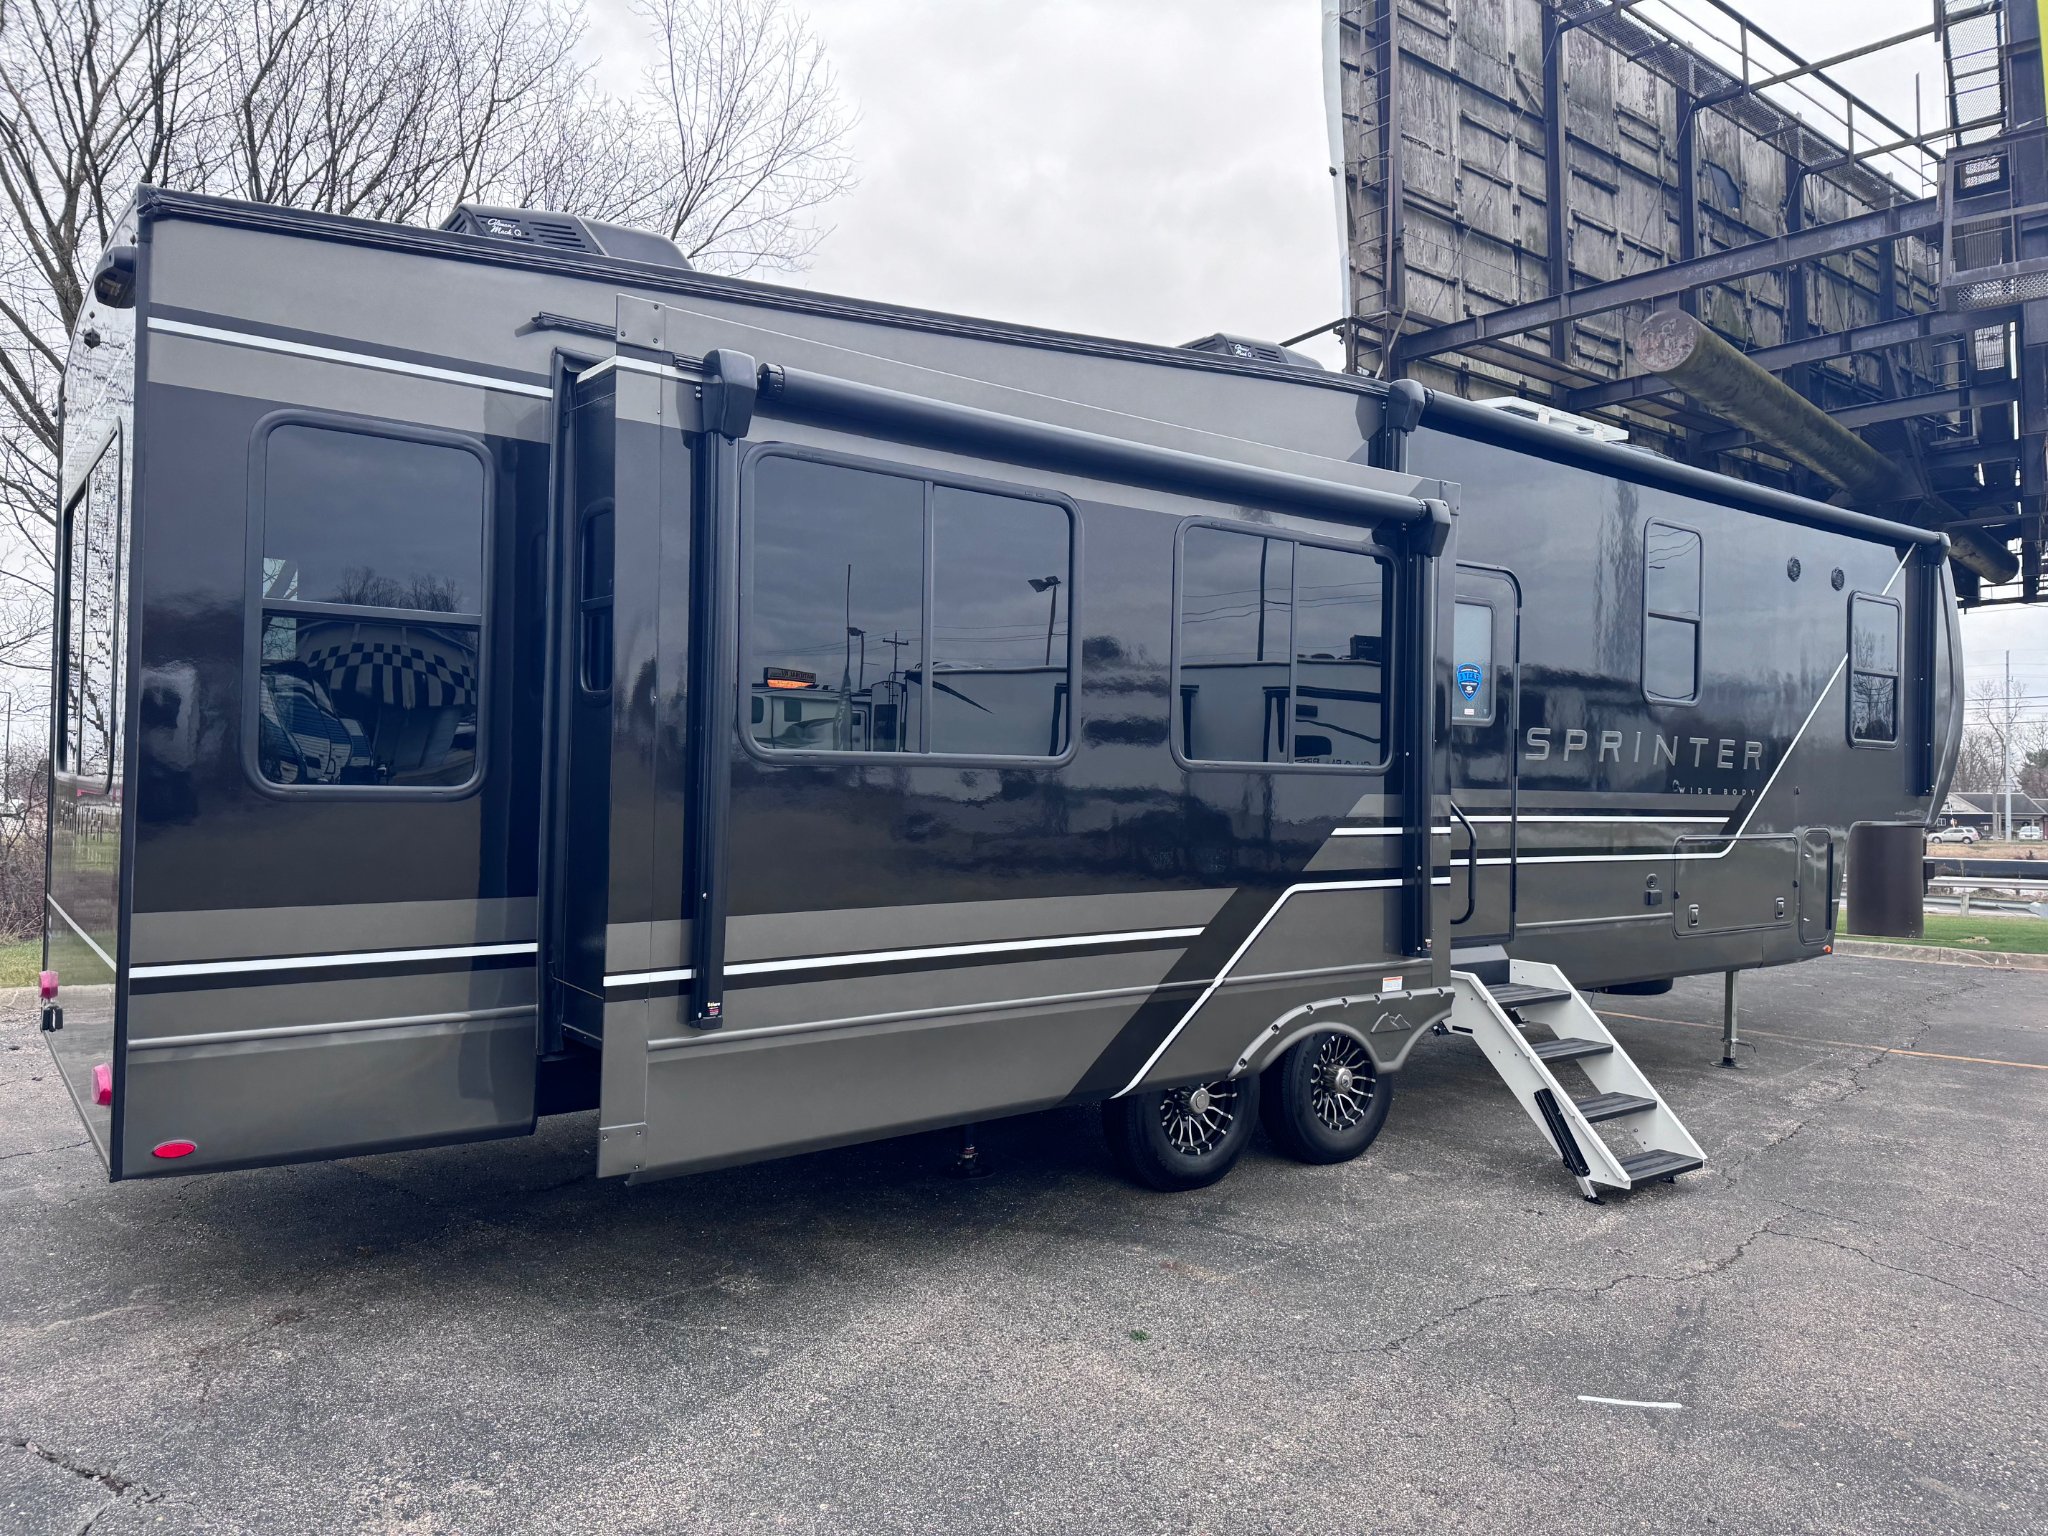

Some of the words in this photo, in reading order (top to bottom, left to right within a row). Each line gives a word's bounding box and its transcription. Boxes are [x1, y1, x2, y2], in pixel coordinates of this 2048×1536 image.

[1525, 727, 1763, 770] SPRINTER
[1678, 786, 1712, 795] WIDE
[1723, 788, 1756, 797] BODY
